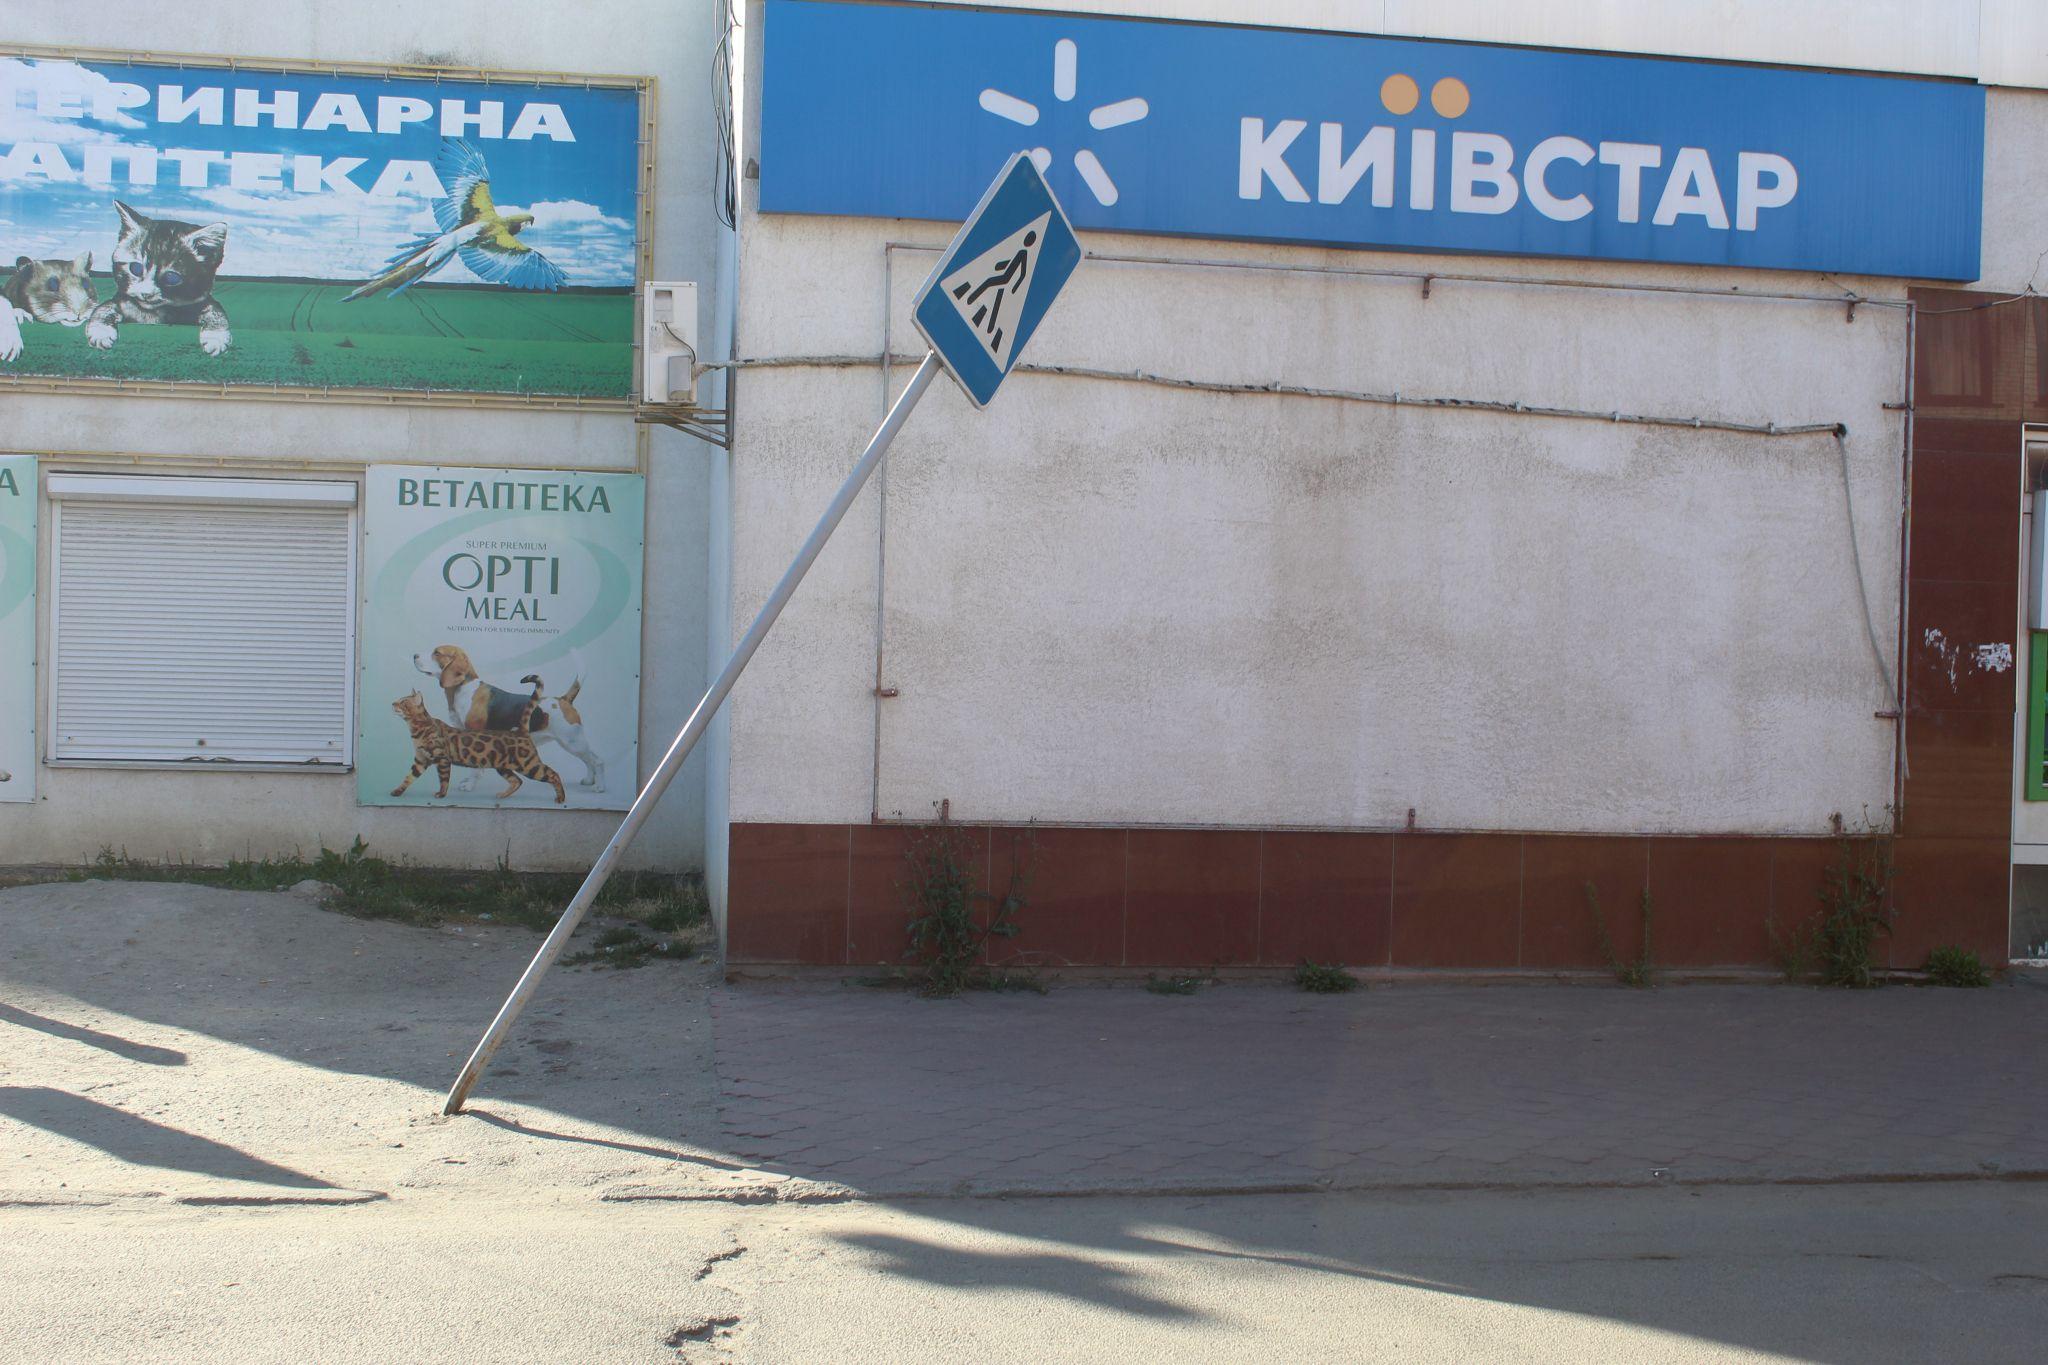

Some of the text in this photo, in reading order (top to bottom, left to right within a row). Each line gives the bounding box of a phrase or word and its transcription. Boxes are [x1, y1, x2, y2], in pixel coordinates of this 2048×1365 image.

[1238, 73, 1799, 231] КИЇВСТАР
[0, 142, 449, 199] АПТЕКА
[398, 478, 612, 513] ВЕТАПТЕКА
[465, 540, 547, 550] SUPER PREMIUM
[442, 552, 559, 595] OPTI
[464, 596, 547, 621] MEAL
[447, 625, 483, 633] NUTRITION
